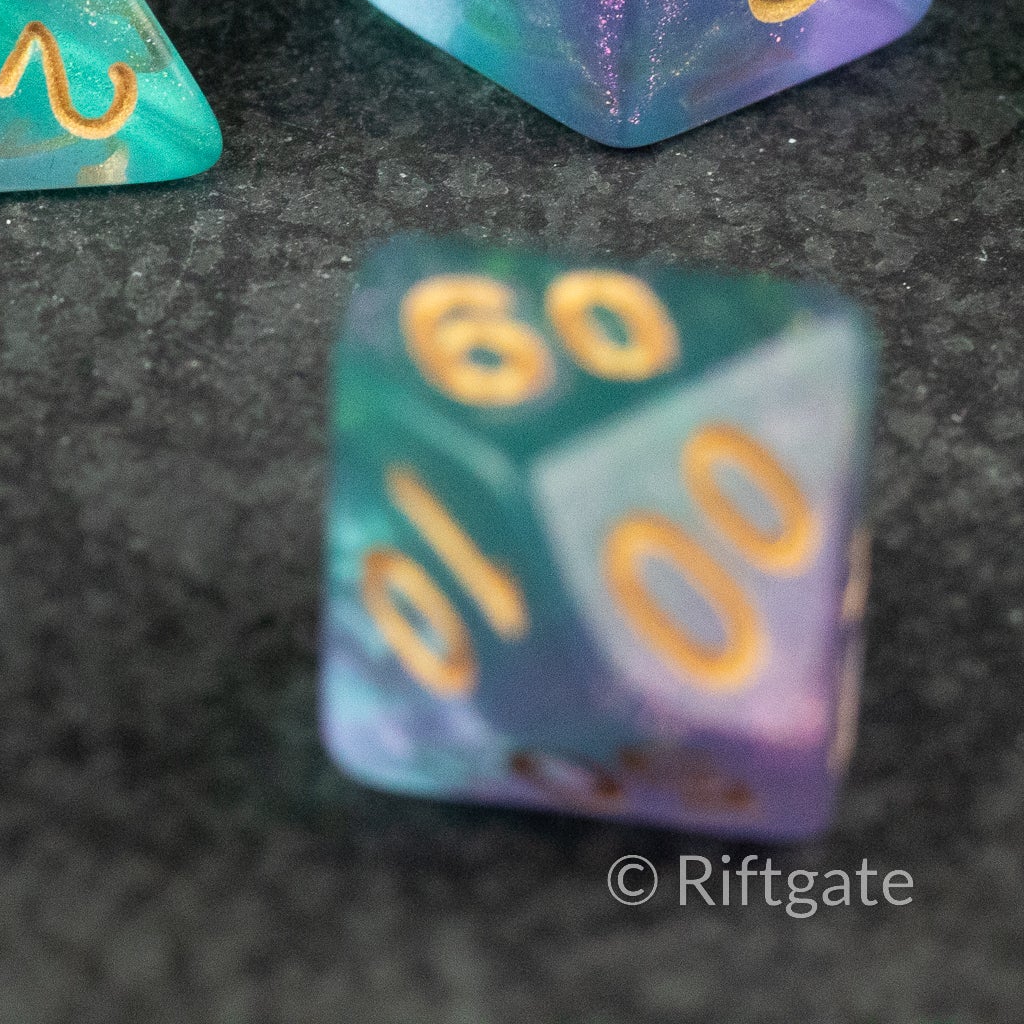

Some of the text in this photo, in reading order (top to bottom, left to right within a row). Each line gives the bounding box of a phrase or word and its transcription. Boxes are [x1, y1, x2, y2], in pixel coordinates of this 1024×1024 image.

[399, 267, 681, 409] 60
[360, 460, 532, 699] 10
[600, 416, 822, 696] 00
